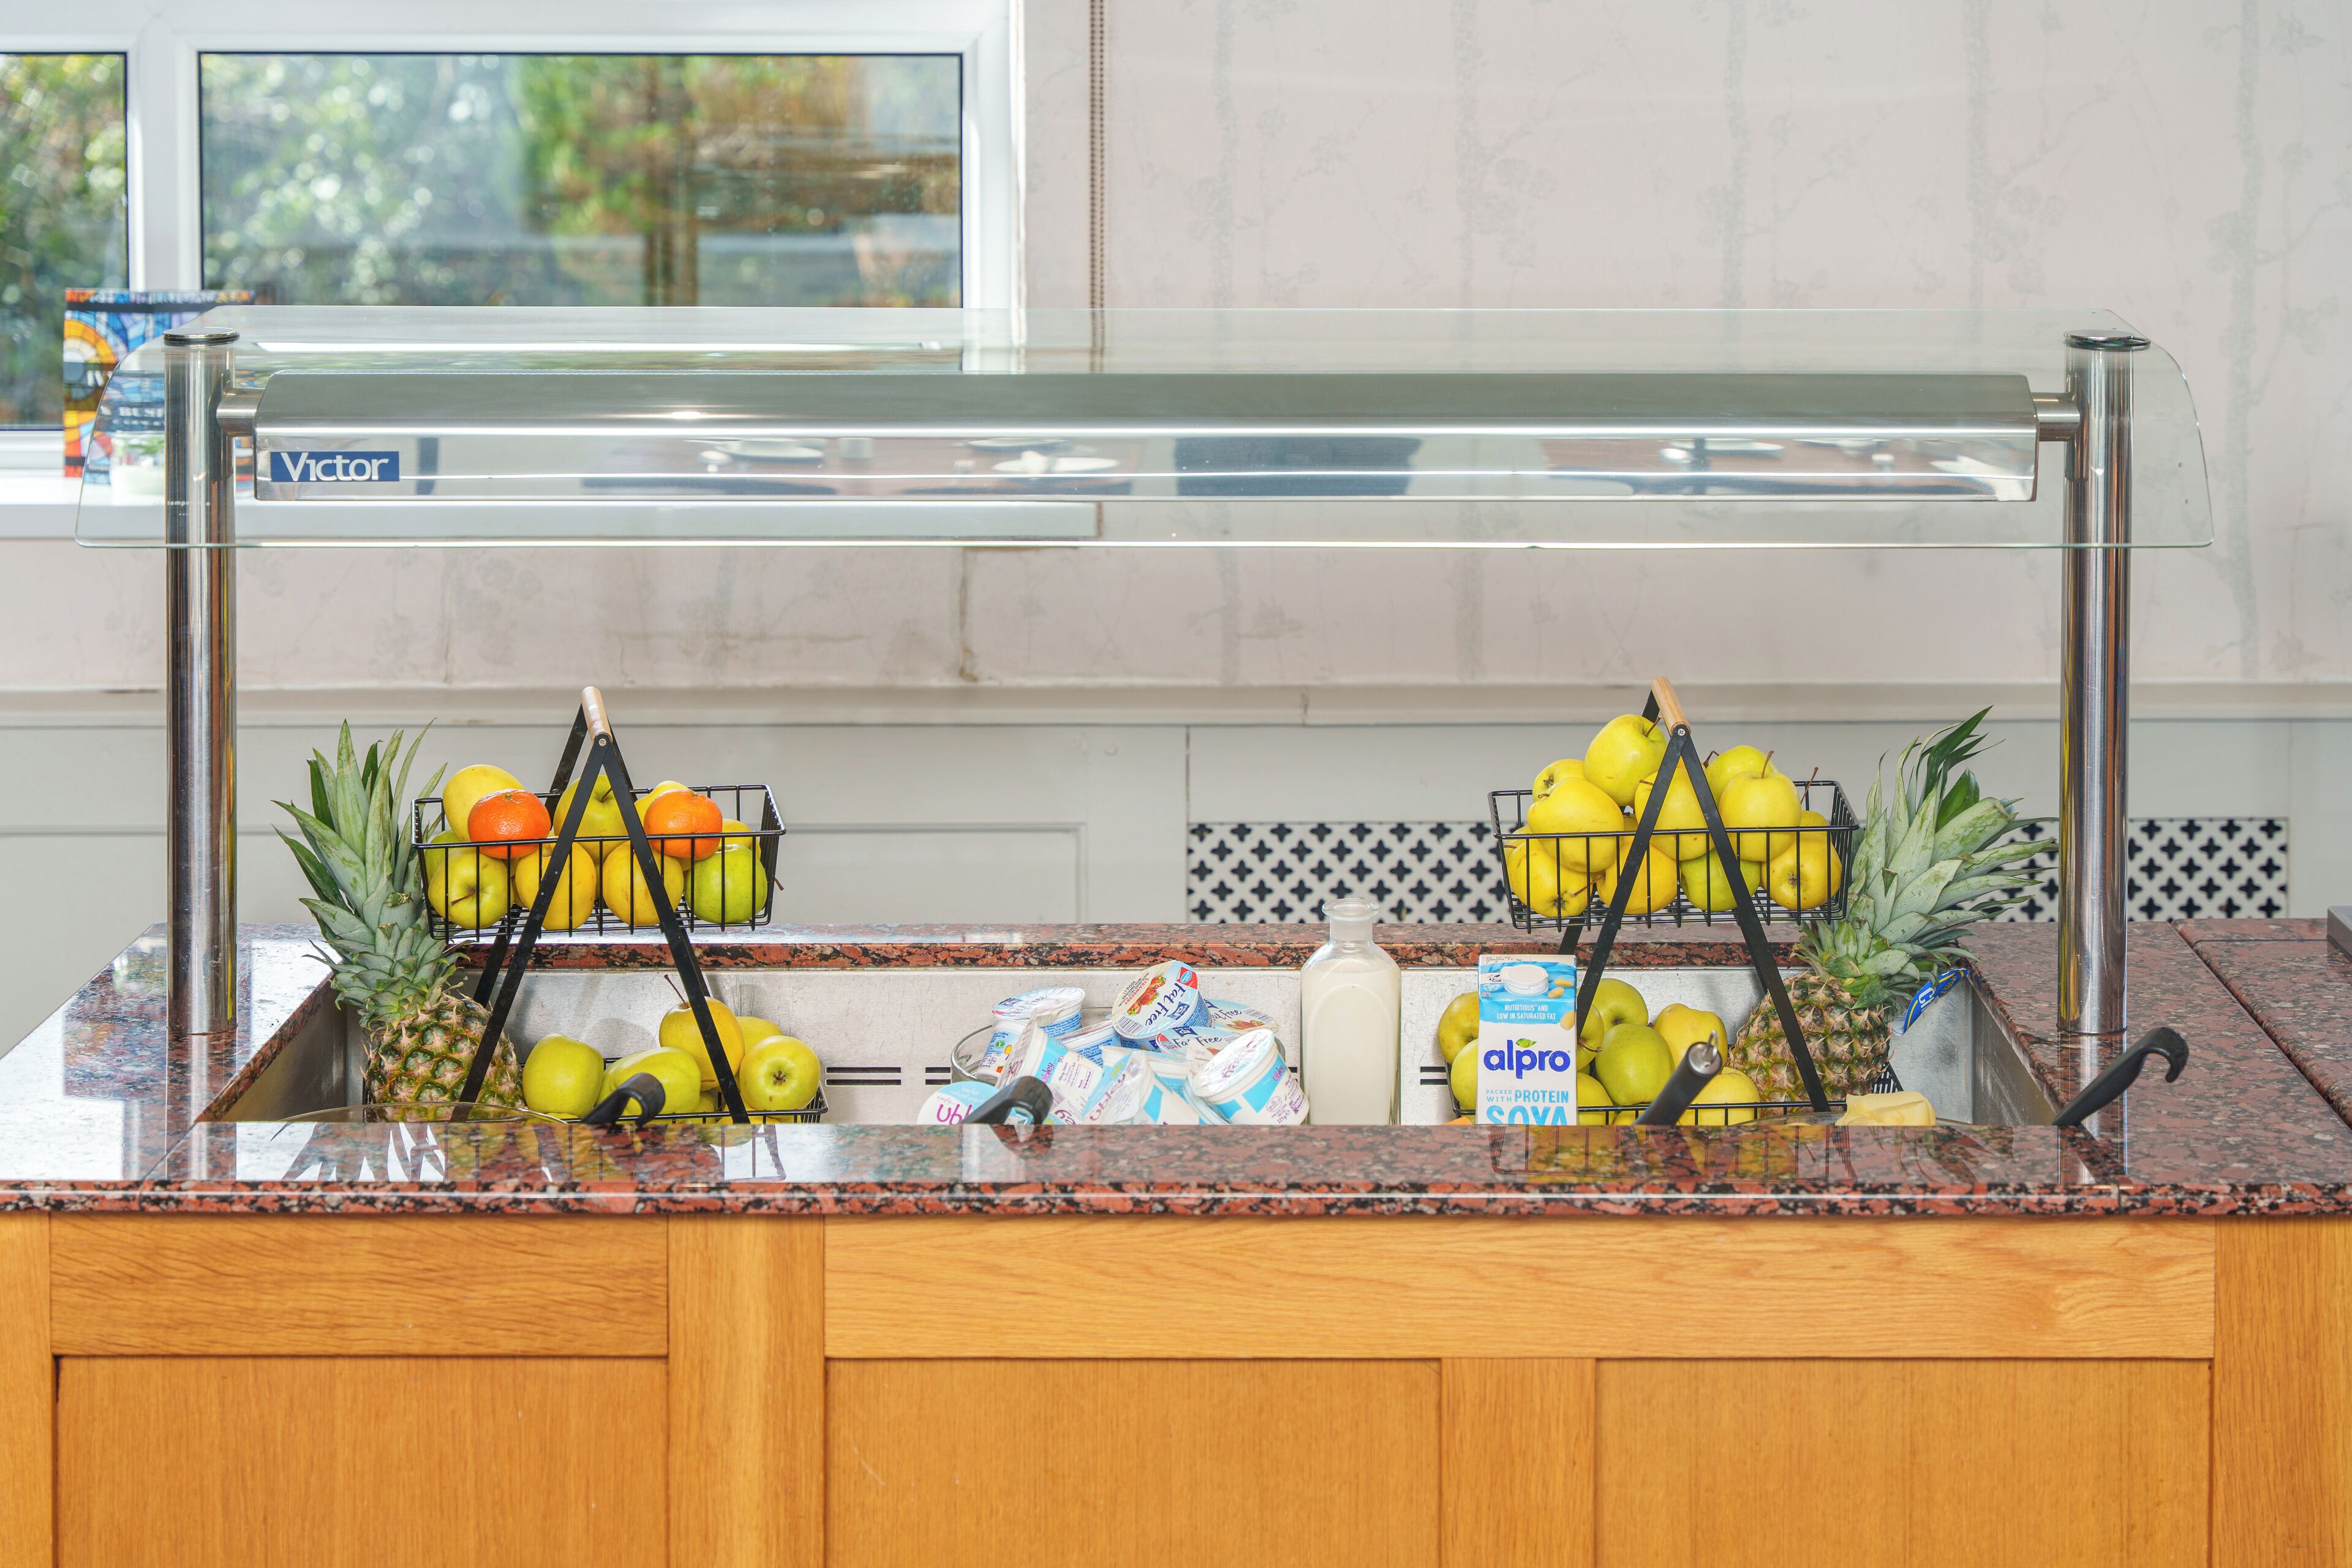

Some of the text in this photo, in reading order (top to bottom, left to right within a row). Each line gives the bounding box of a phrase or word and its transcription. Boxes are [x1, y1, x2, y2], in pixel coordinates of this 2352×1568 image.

[280, 452, 389, 481] Victor
[1124, 978, 1149, 1005] STRAWBERRY
[1164, 982, 1186, 1004] Fat
[1145, 1002, 1169, 1027] Free
[1212, 1012, 1226, 1021] at
[1195, 1036, 1223, 1046] Free
[1483, 1039, 1570, 1079] alpro
[1515, 1090, 1569, 1103] PROTEIN
[937, 1104, 973, 1125] Ubl
